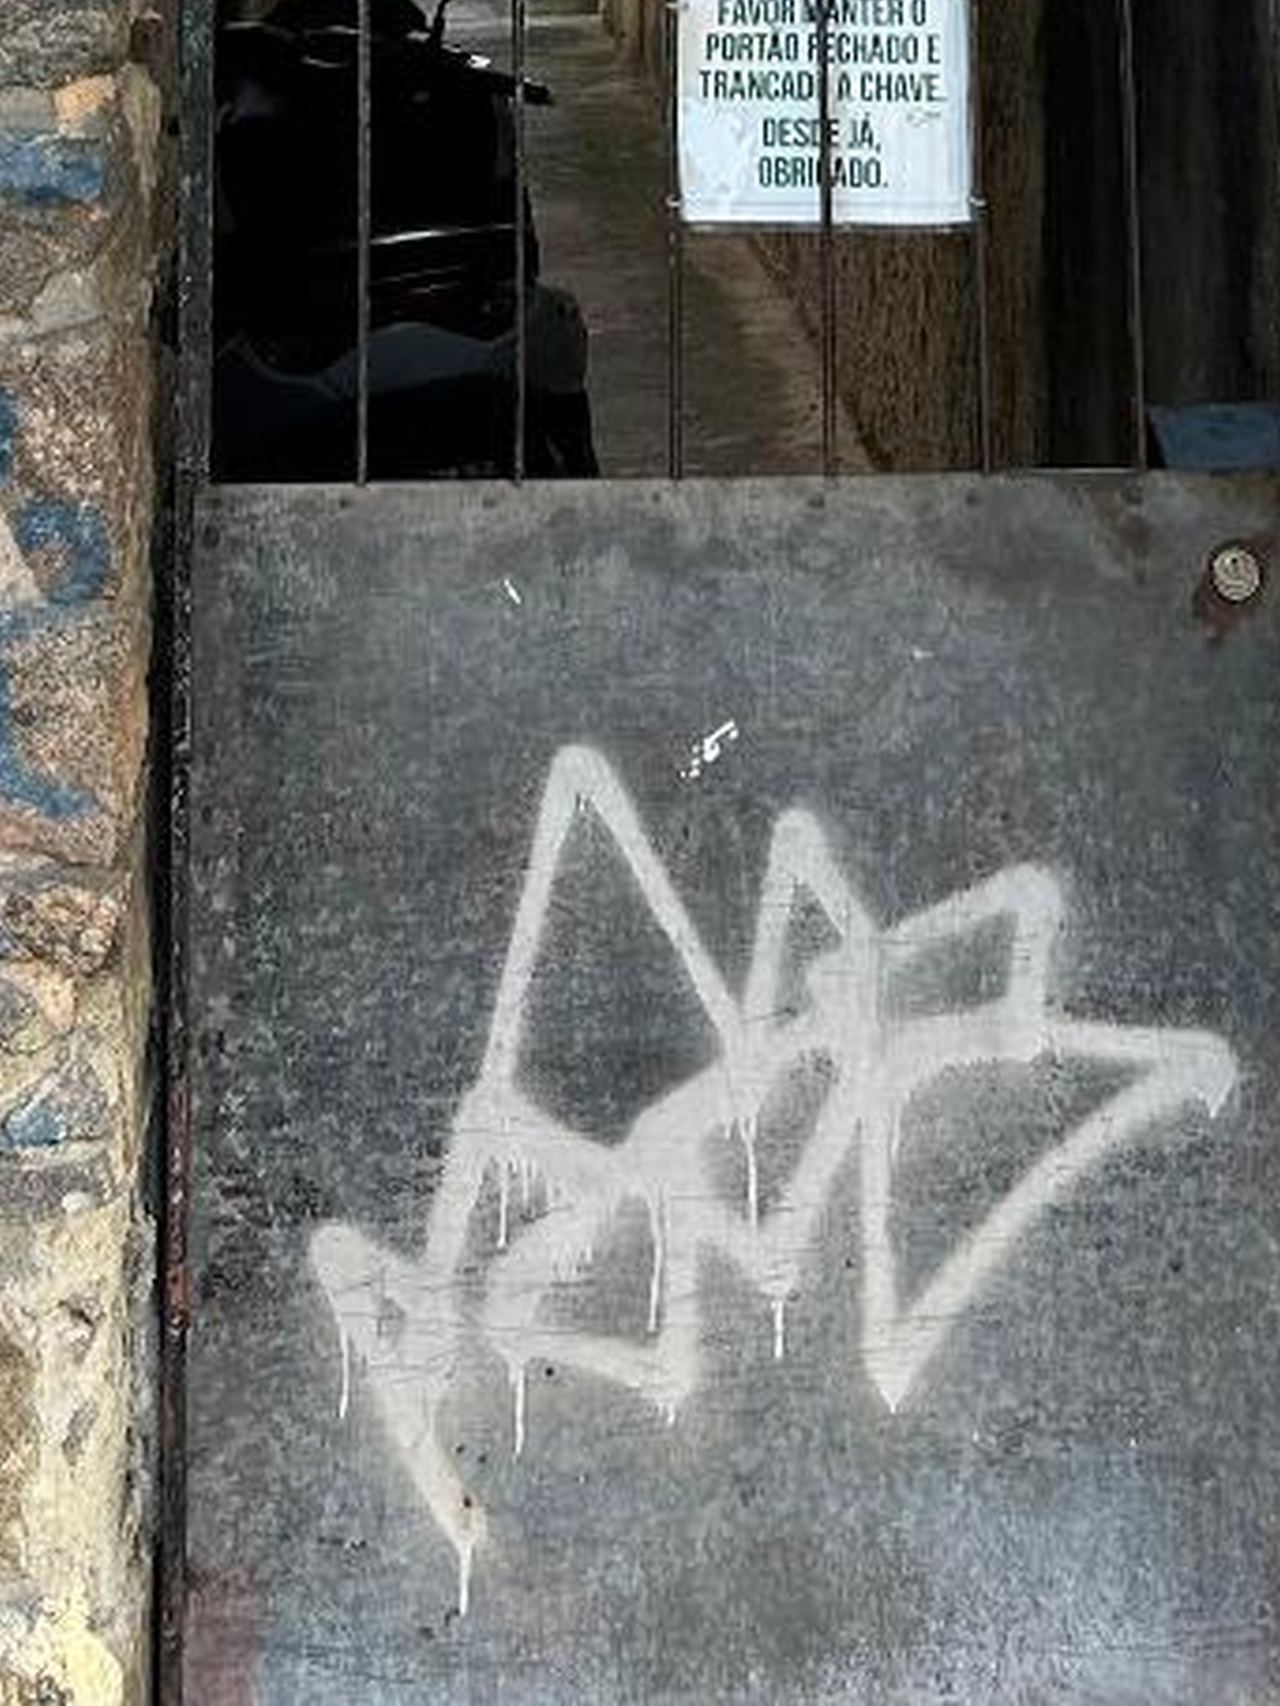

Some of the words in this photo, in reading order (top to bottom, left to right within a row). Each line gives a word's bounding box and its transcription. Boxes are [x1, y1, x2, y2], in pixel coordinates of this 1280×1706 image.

[706, 29, 798, 62] PORTÃO
[929, 35, 940, 65] E
[700, 71, 825, 100] TRANCAD
[838, 71, 852, 101] A
